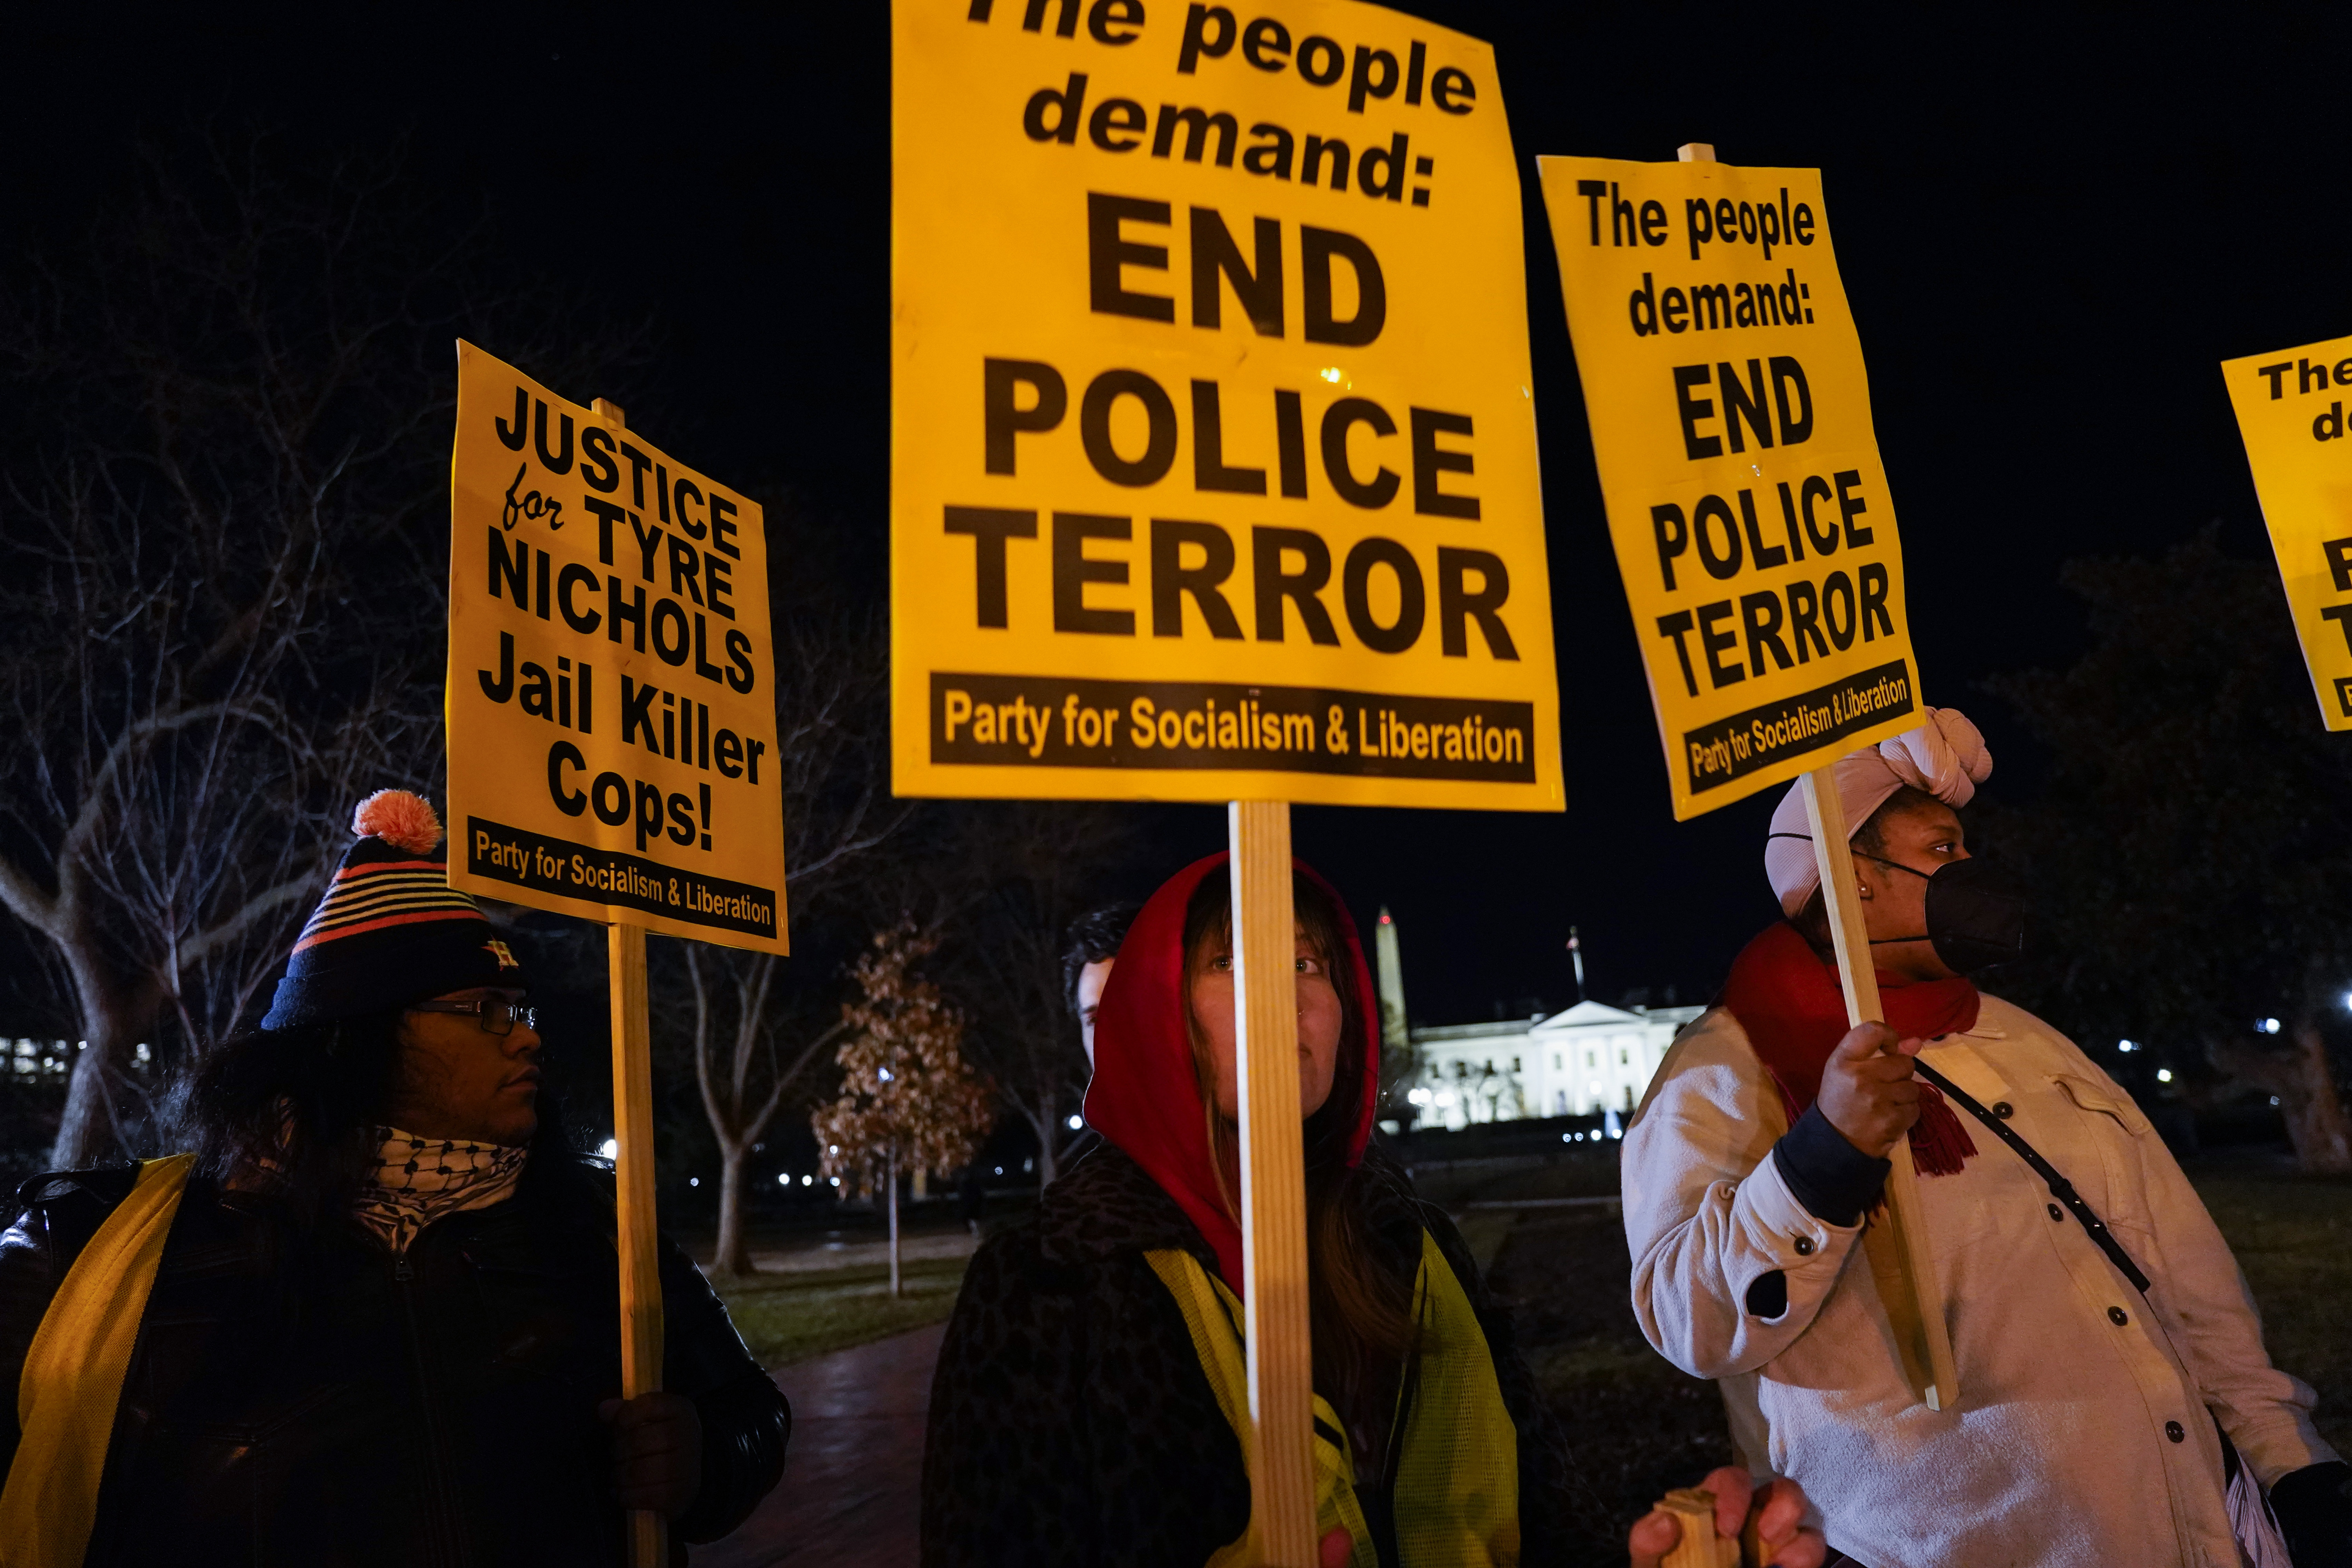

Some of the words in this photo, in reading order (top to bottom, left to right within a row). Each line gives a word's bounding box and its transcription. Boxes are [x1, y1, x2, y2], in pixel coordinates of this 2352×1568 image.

[1178, 3, 1476, 115] people
[1023, 73, 1434, 207] demand:
[1088, 192, 1386, 347] END
[1578, 180, 1668, 247] The
[1686, 187, 1815, 260] people
[1630, 269, 1814, 337] demand:
[985, 358, 1481, 520] POLICE
[1673, 356, 1813, 461] END
[495, 386, 741, 561] JUSTICE
[1651, 470, 1874, 592] POLICE
[503, 462, 564, 532] for
[584, 495, 736, 621] TYRE
[944, 506, 1520, 661] TERROR
[488, 525, 755, 695] NICHOLS
[1657, 562, 1895, 697] TERROR
[478, 630, 592, 734] Jail
[621, 674, 766, 785] Killer
[944, 689, 1052, 759] Party
[1061, 693, 1120, 748] for
[1130, 696, 1315, 751] Socialism
[1325, 704, 1349, 754] &
[1359, 708, 1523, 763] Liberation
[1690, 739, 1732, 777] Party
[1729, 729, 1751, 761] for
[1751, 705, 1833, 752] Socialism
[1832, 694, 1843, 725] &
[1842, 676, 1907, 721] Liberation
[547, 740, 711, 853] Cops!
[476, 830, 529, 879] Party
[535, 846, 566, 880] for
[571, 854, 662, 902] Socialism
[668, 877, 681, 906] &
[686, 882, 770, 925] Liberation
